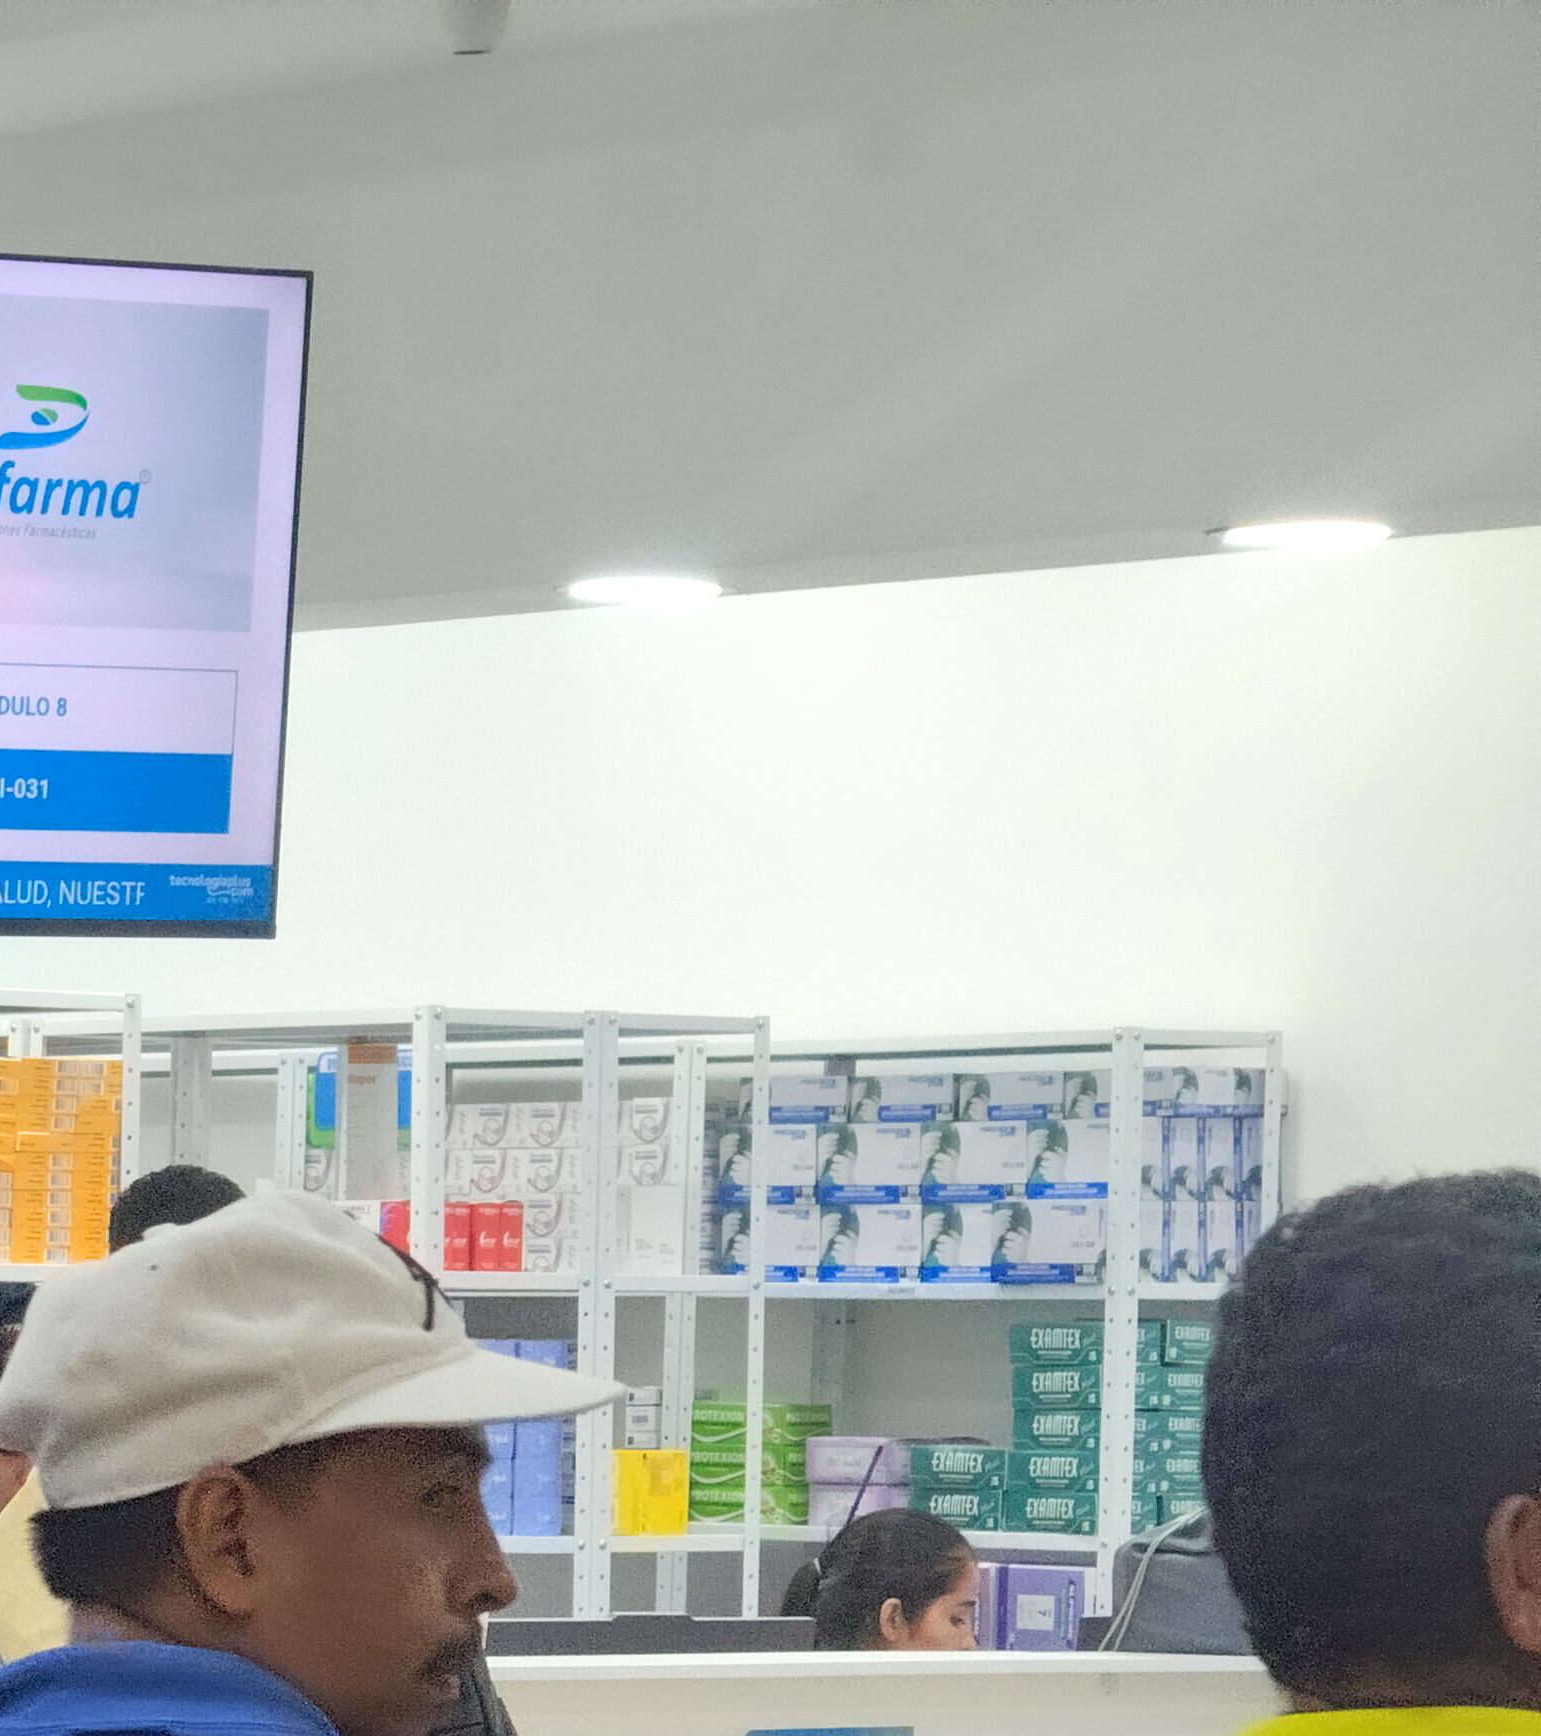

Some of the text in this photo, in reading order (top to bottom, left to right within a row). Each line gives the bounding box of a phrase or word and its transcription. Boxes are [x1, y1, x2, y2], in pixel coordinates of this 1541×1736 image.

[56, 698, 68, 717] 8
[1030, 1328, 1081, 1349] EXAMTEX
[1032, 1371, 1080, 1393] EXAMTEX
[1032, 1414, 1080, 1435] EXAMTEX
[932, 1452, 984, 1473] EXAMTEX
[1028, 1457, 1079, 1477] EXAMTEX
[929, 1494, 979, 1516] EXAMTEX
[1025, 1498, 1074, 1519] EXAMTEX
